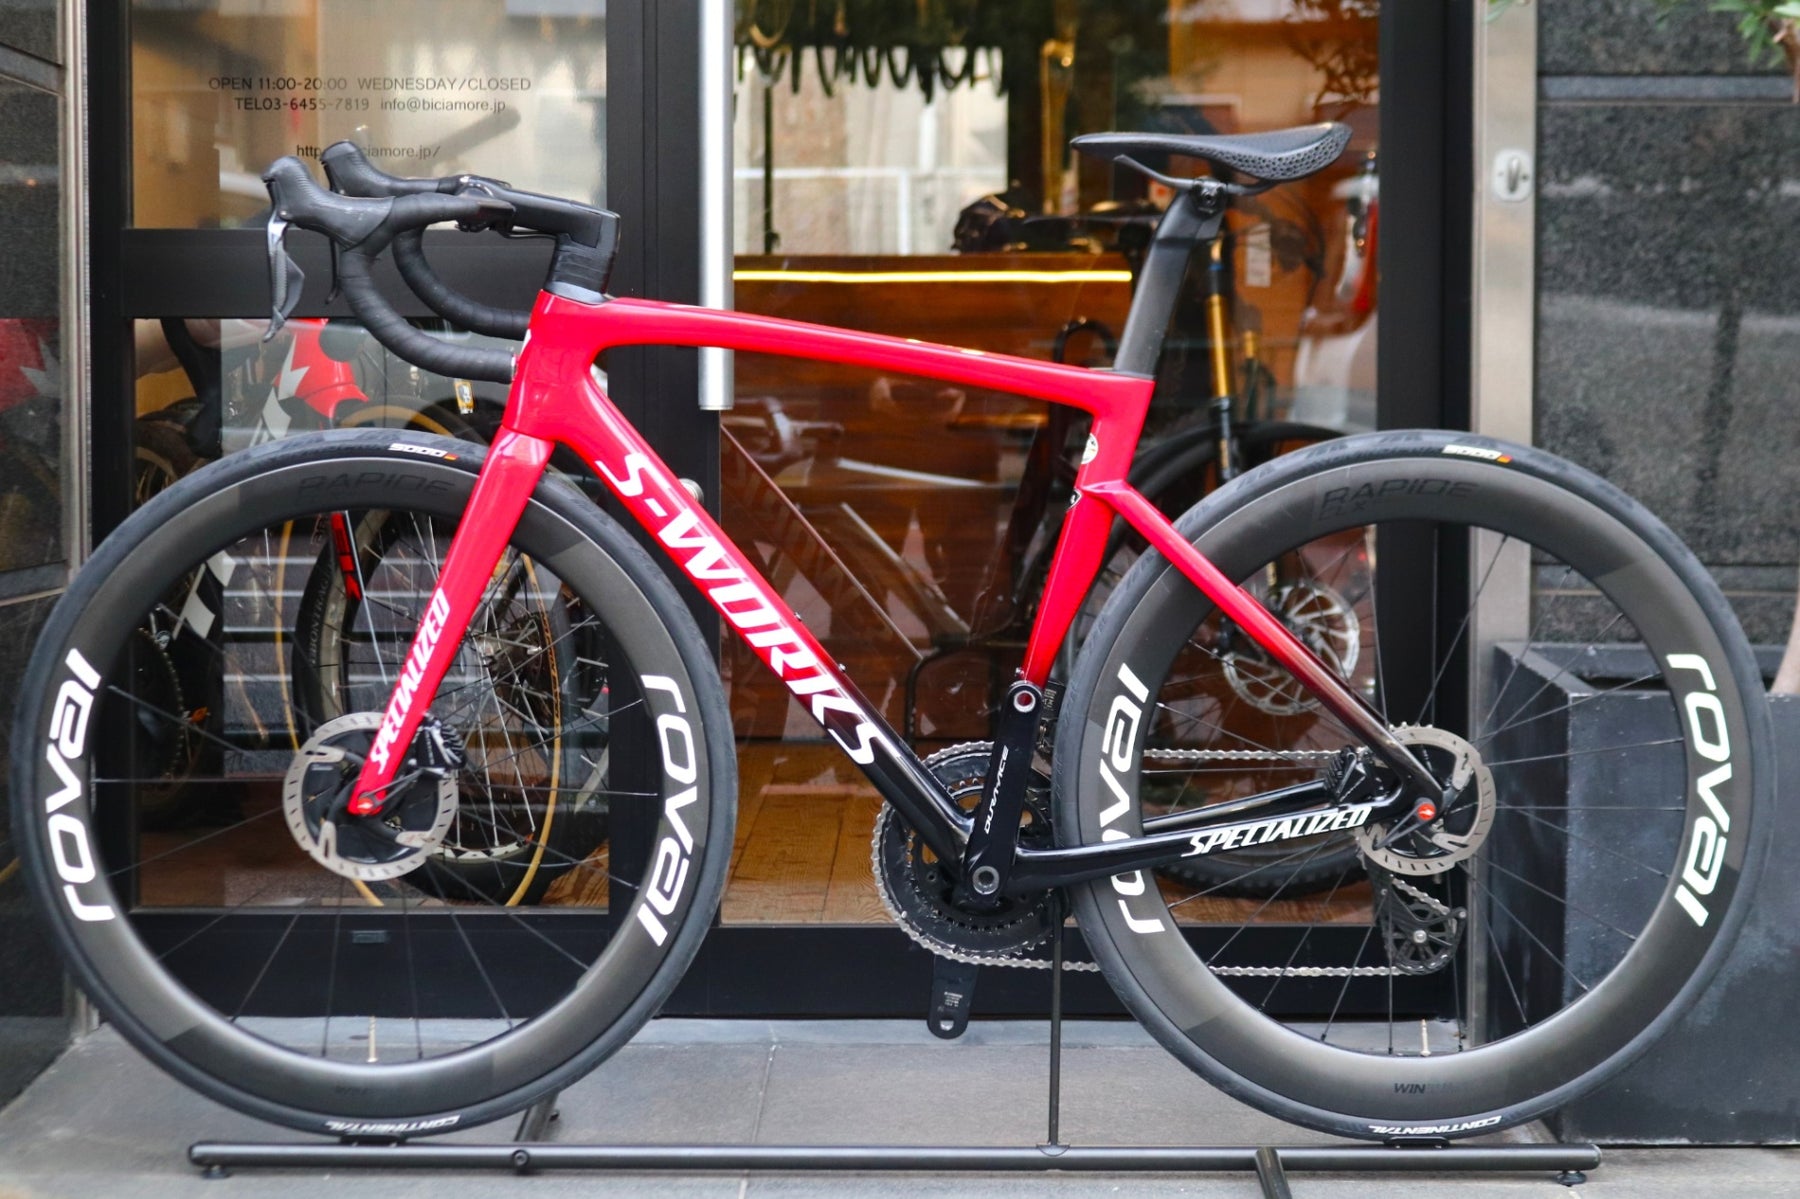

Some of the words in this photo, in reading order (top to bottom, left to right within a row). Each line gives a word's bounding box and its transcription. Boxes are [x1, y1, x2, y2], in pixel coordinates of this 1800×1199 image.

[208, 77, 253, 91] OPEN
[258, 77, 347, 91] 11:00-20:00
[358, 77, 532, 91] WEDNESDAY/CLOSED
[380, 97, 506, 115] info@biciamore.jp
[1321, 479, 1479, 509] RAPIDE
[595, 452, 888, 765] S-WORKS
[370, 588, 451, 776] SPECIALIZED
[43, 648, 115, 922] roval
[1667, 653, 1733, 927] roval
[636, 674, 698, 947] roval
[1181, 807, 1372, 857] SPECIALIZED
[325, 1115, 460, 1133] CONTINENTAL
[1368, 1116, 1501, 1134] CONTINENTAL
